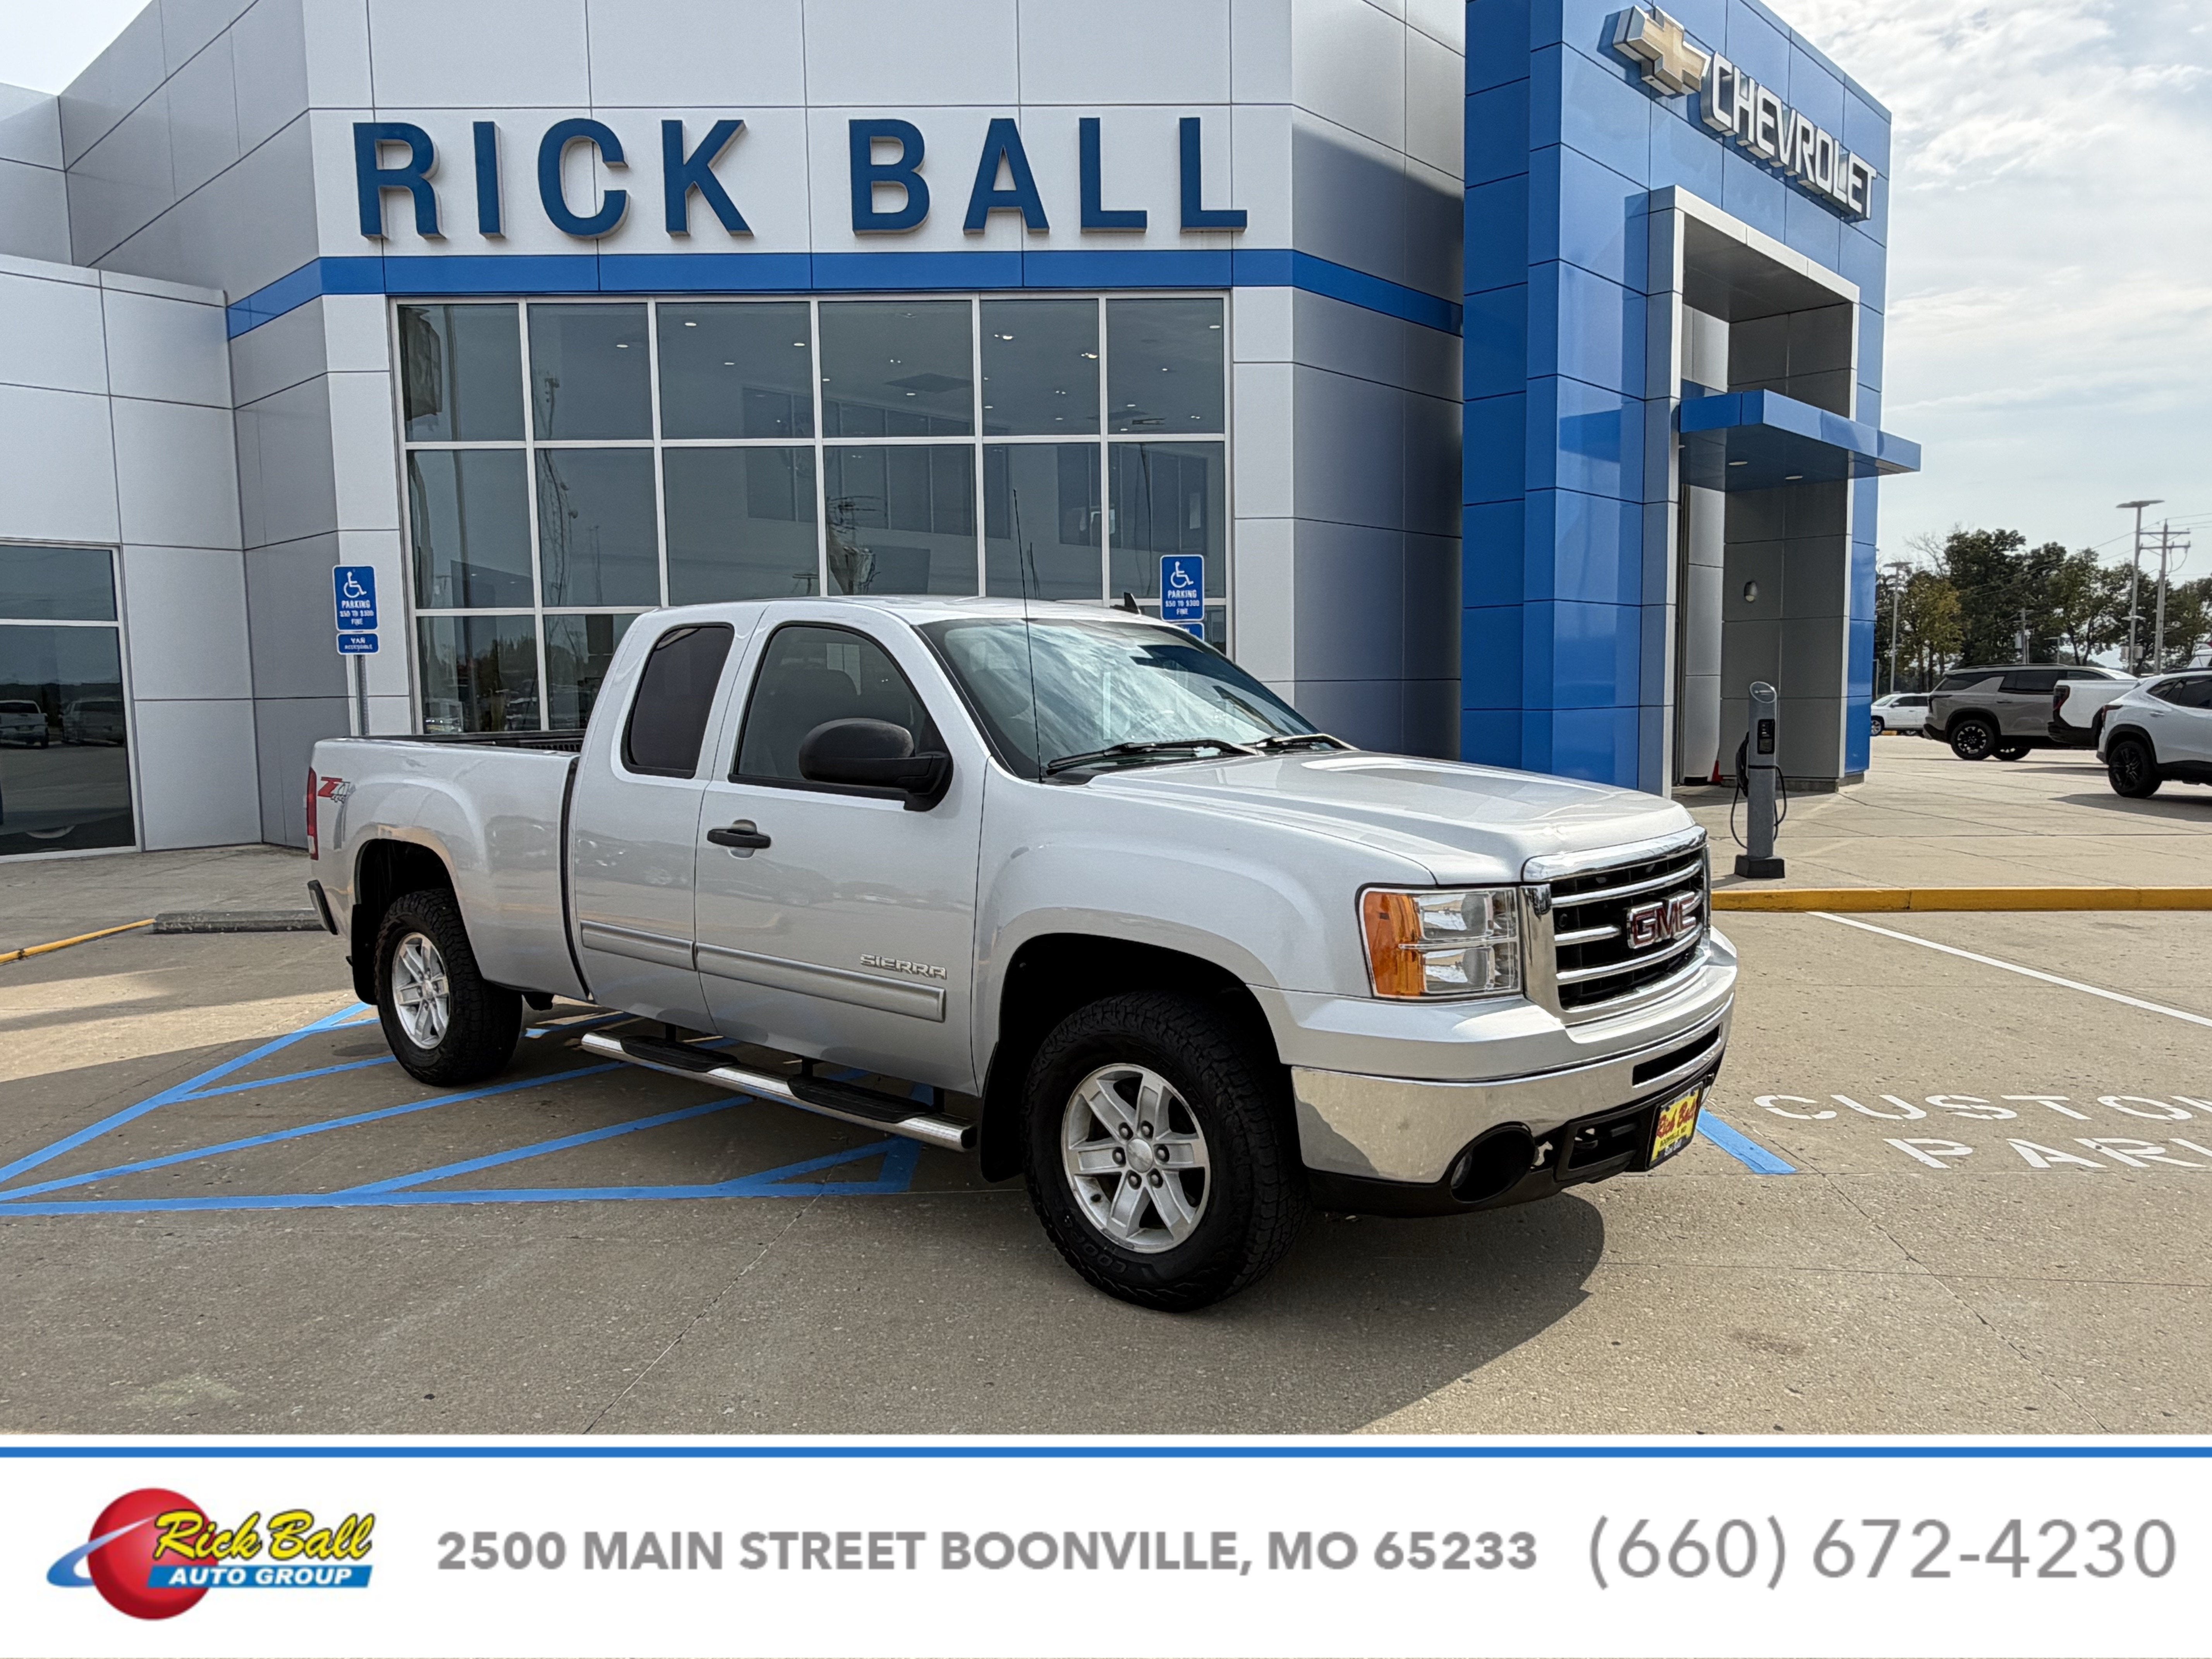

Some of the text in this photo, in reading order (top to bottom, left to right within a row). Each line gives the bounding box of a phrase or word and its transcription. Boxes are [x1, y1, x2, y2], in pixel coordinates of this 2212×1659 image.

[1709, 50, 1877, 220] CHEVROLET
[353, 117, 1247, 237] RICK BALL
[342, 599, 370, 609] PARKING
[1168, 589, 1197, 598] PARKING
[1628, 891, 1700, 949] GMC
[860, 953, 947, 980] SIERRA
